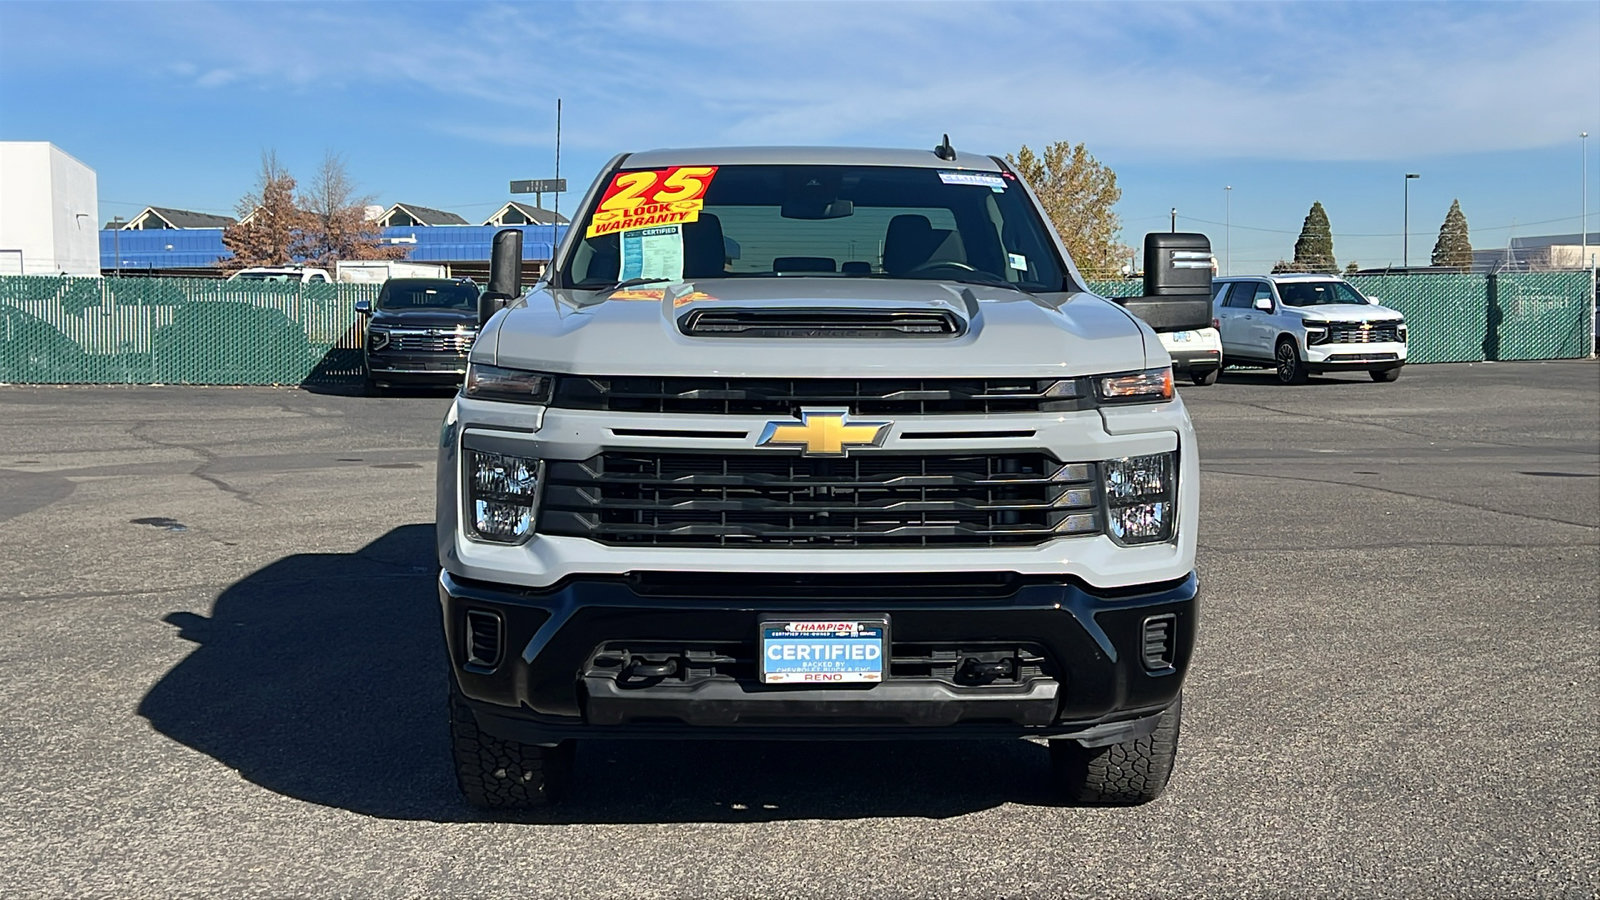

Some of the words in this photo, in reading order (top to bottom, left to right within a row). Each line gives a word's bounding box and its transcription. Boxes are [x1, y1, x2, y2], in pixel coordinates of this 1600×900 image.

[600, 167, 715, 211] 25
[623, 203, 673, 217] LOOK
[595, 212, 690, 233] WARRANTY
[642, 227, 677, 236] CERTIFIED
[794, 623, 853, 631] CHAMPION
[767, 644, 880, 660] CERTIFIED
[804, 673, 842, 681] RENO
